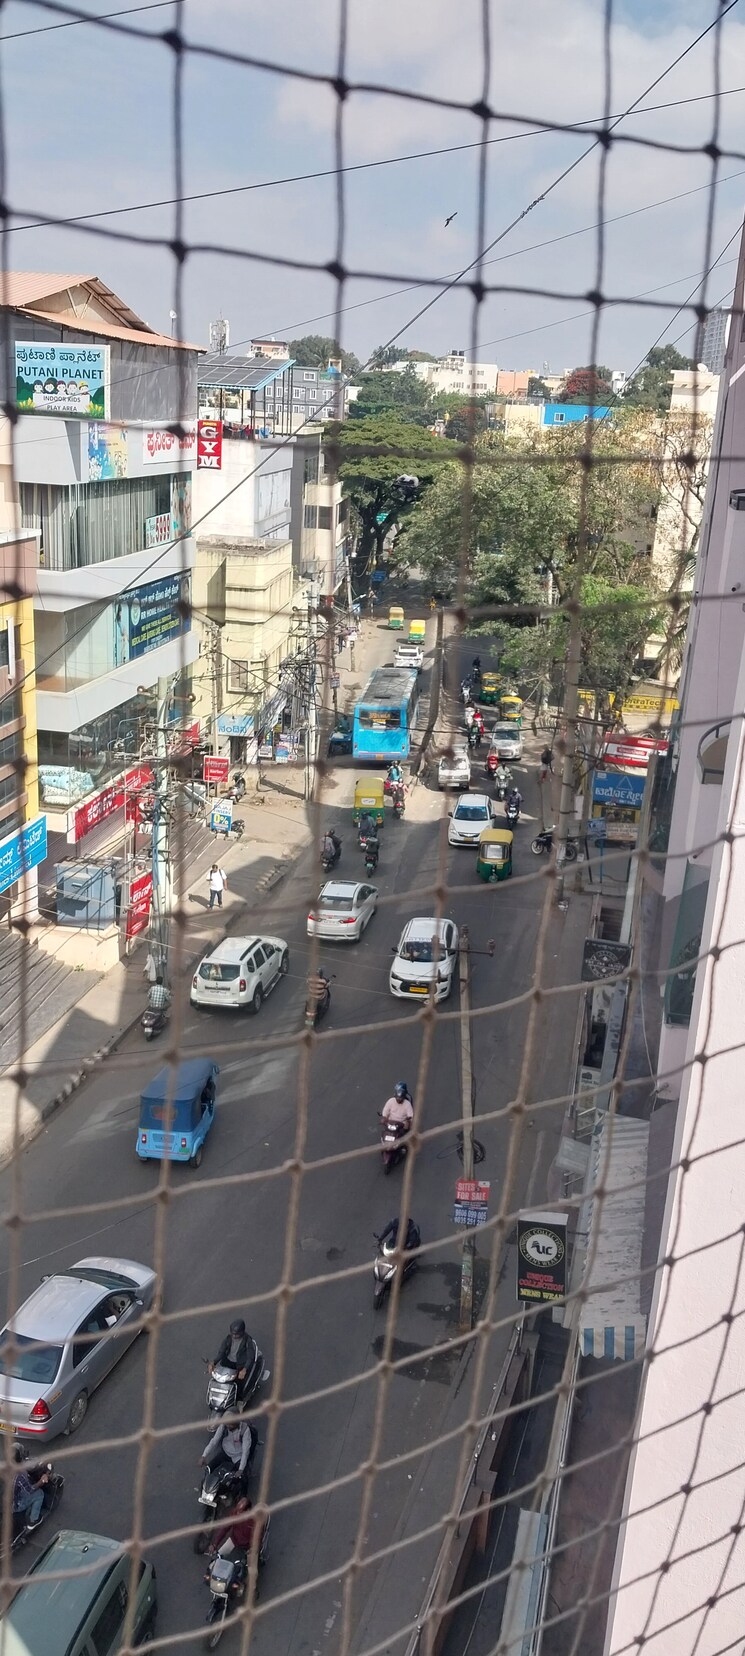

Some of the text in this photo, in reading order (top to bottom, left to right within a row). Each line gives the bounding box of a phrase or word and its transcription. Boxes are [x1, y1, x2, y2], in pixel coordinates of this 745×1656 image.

[16, 347, 101, 364] ಪುಟಾಣಿ ಪ್ಲಾನೆಟ್
[17, 366, 104, 379] PUTANI PLANET
[198, 426, 221, 467] GYM
[457, 1182, 476, 1191] SITES
[456, 1191, 486, 1201] FOR SALE
